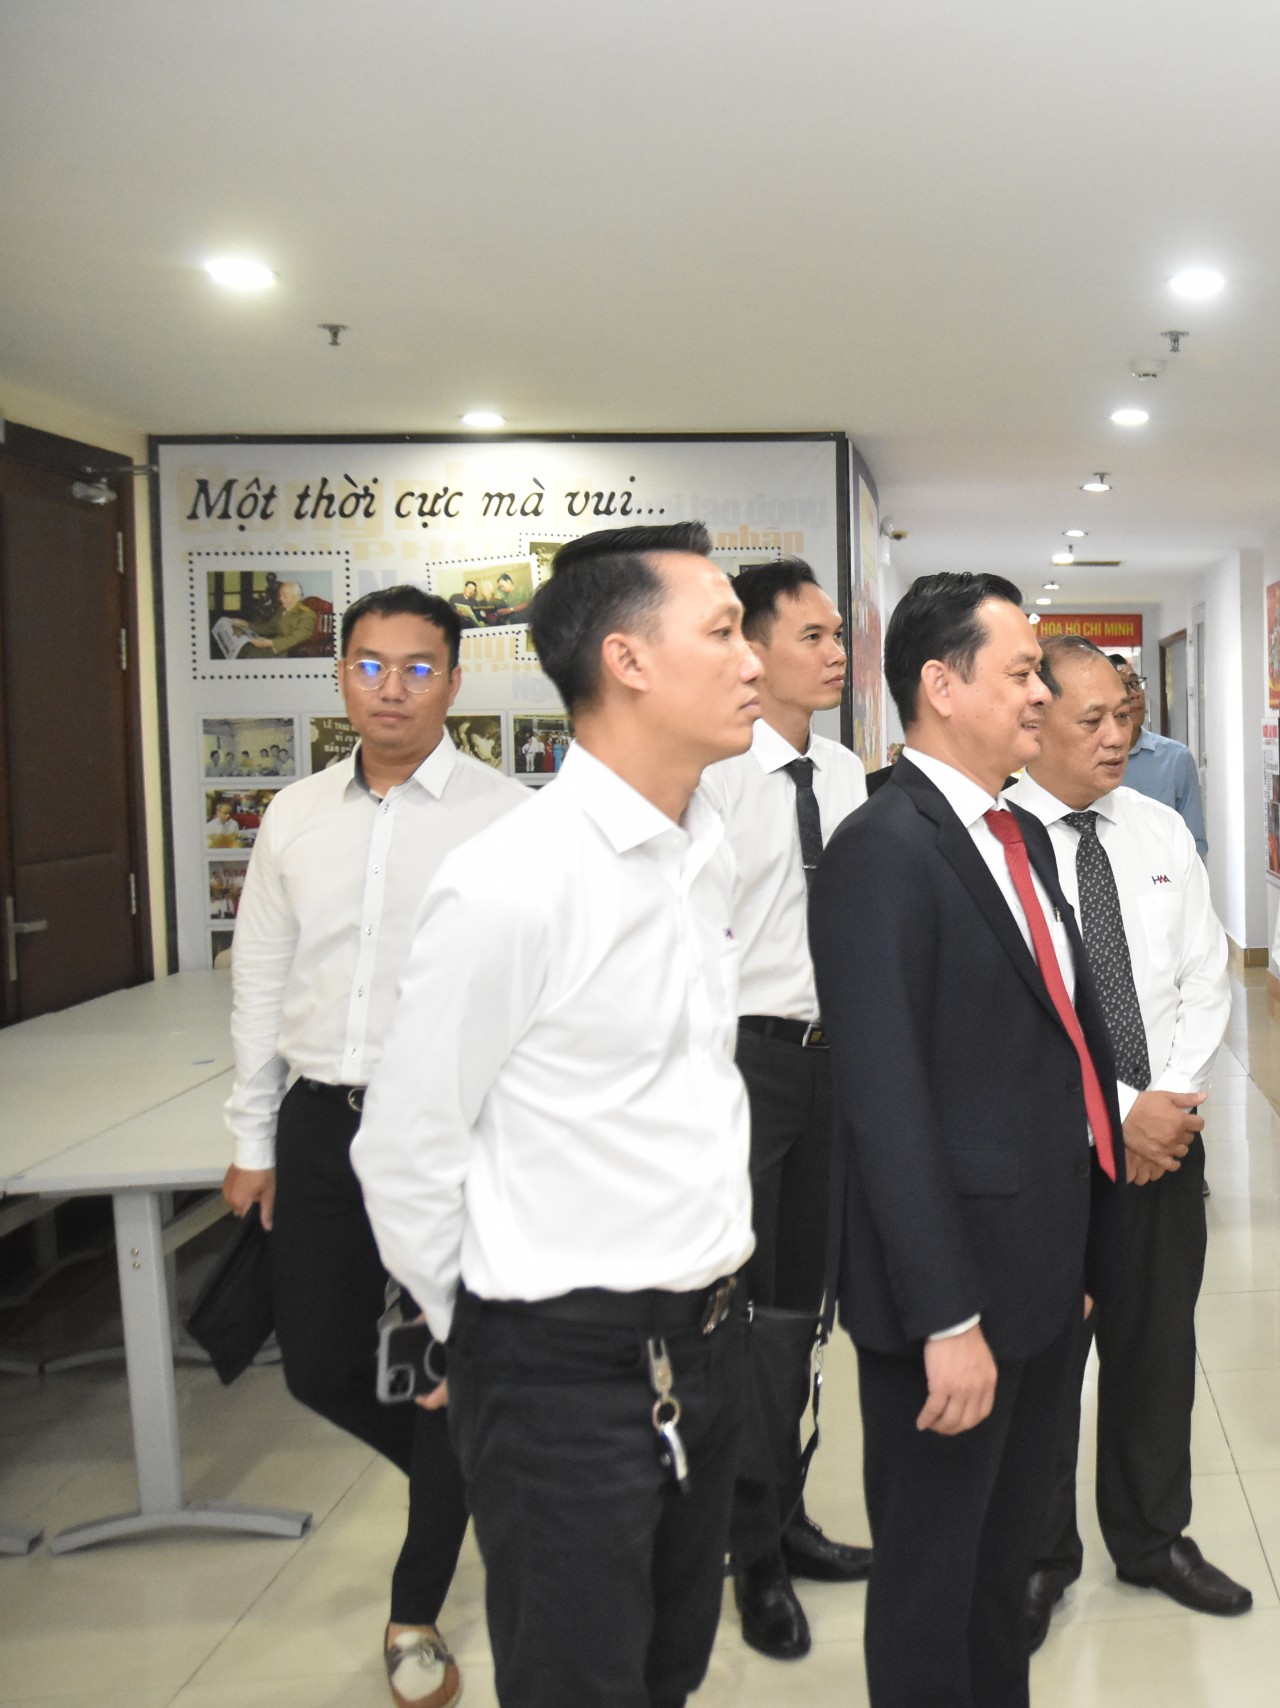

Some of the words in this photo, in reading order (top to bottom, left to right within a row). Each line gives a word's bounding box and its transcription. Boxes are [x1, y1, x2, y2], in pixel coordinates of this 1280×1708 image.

[187, 477, 277, 531] Một
[294, 473, 379, 520] thời
[395, 486, 463, 529] cực
[482, 477, 546, 517] mà
[565, 475, 665, 517] vui...
[1104, 622, 1134, 636] MINH
